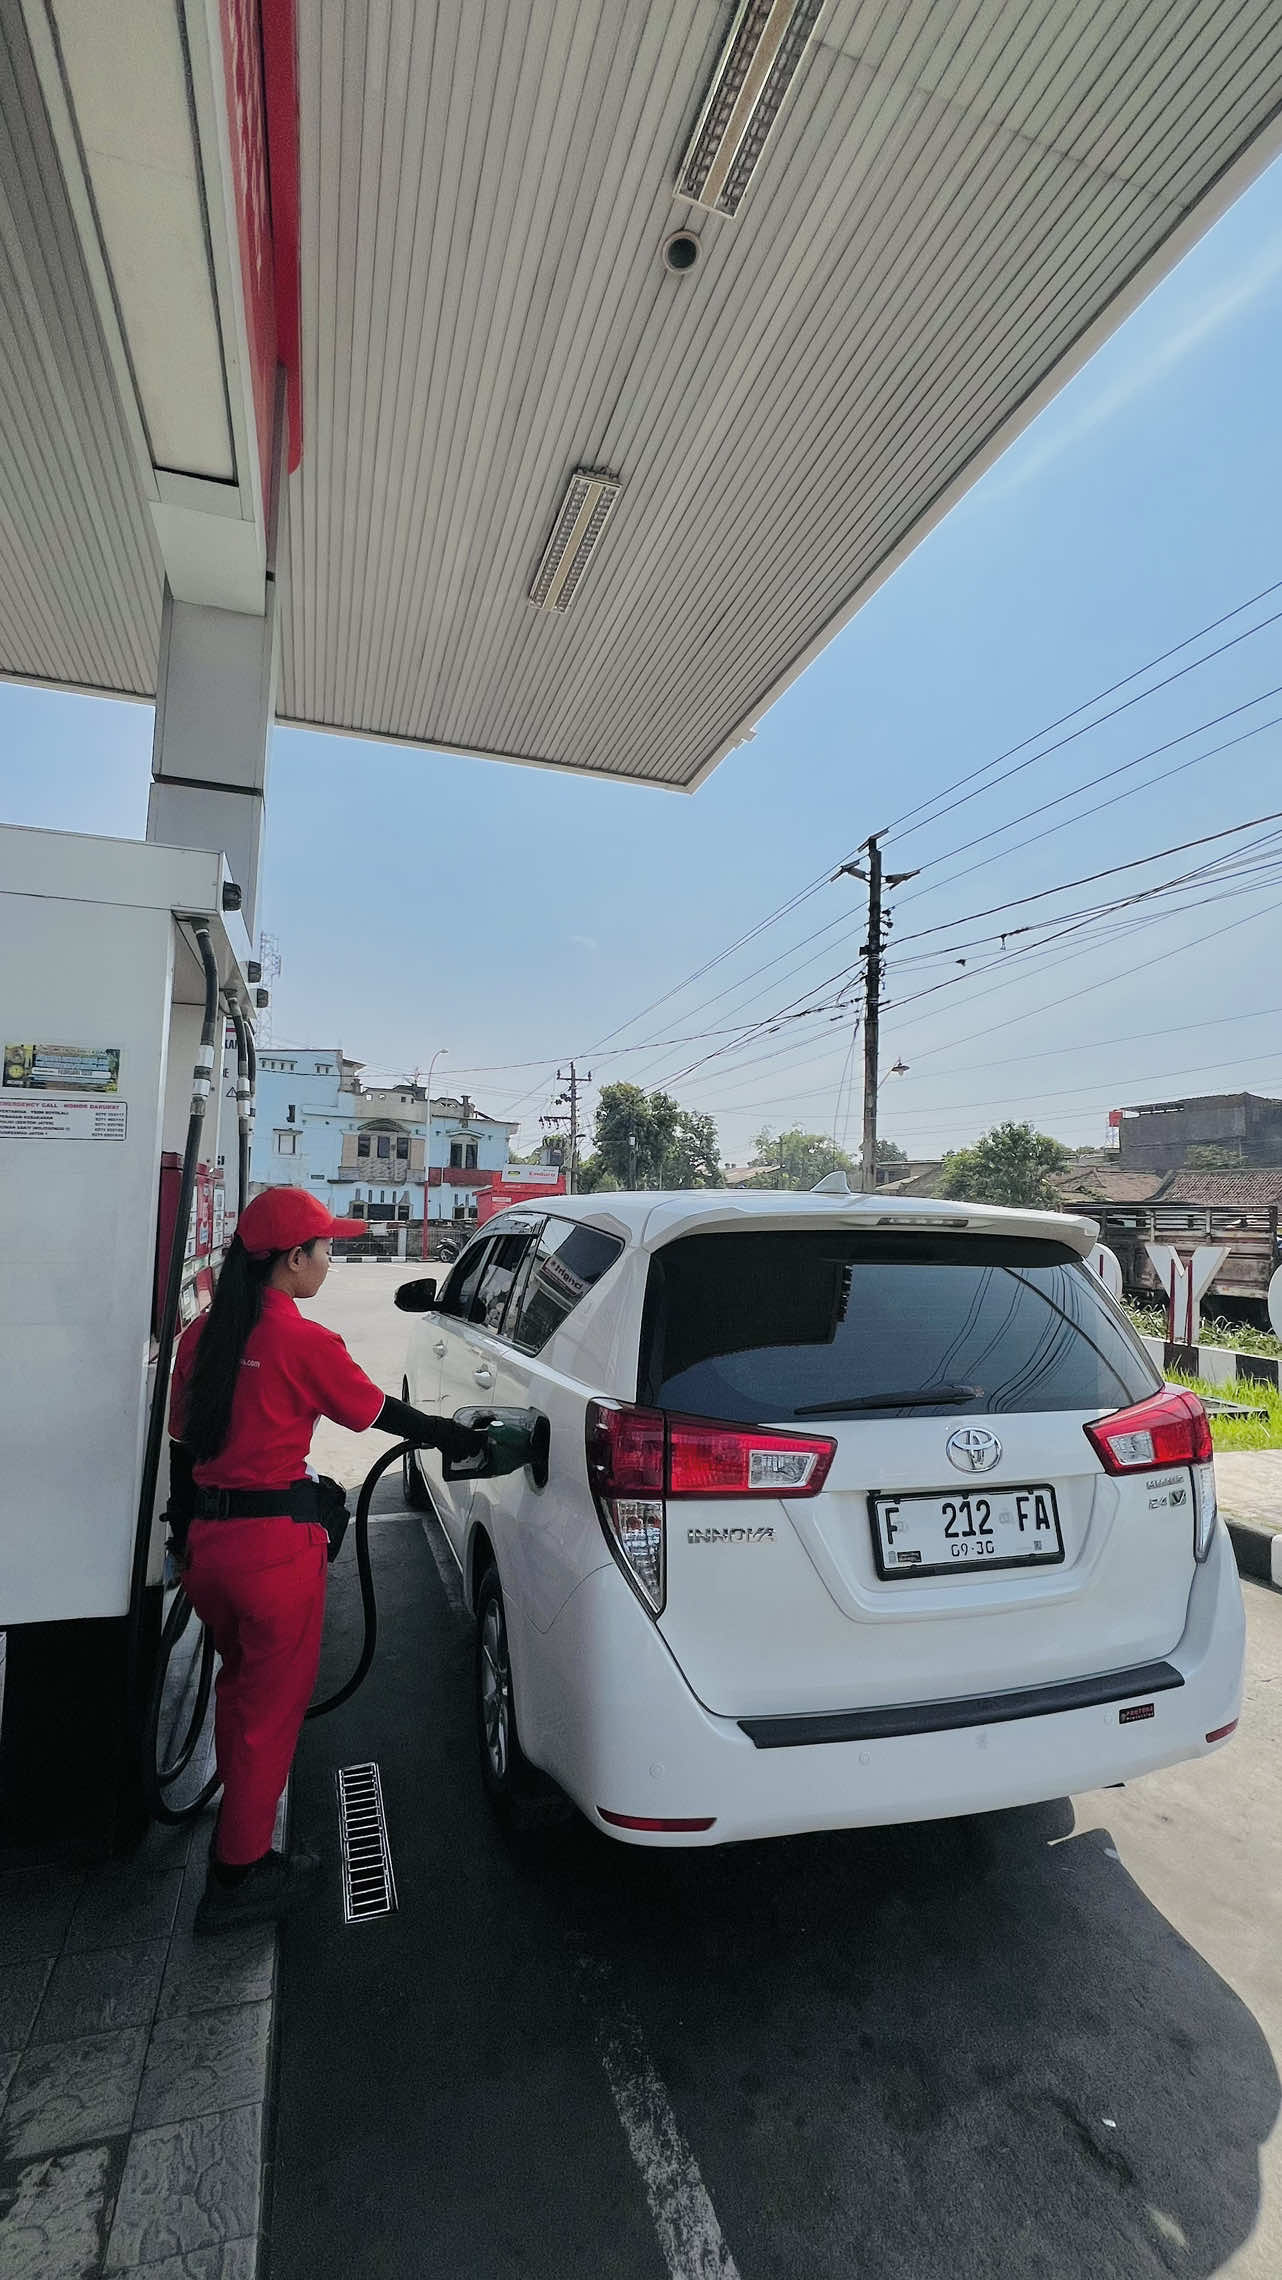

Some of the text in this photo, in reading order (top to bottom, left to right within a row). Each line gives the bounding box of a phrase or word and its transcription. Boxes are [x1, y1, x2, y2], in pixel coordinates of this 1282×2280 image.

[687, 1527, 776, 1544] INNOVA
[885, 1495, 1051, 1545] F 212 FA
